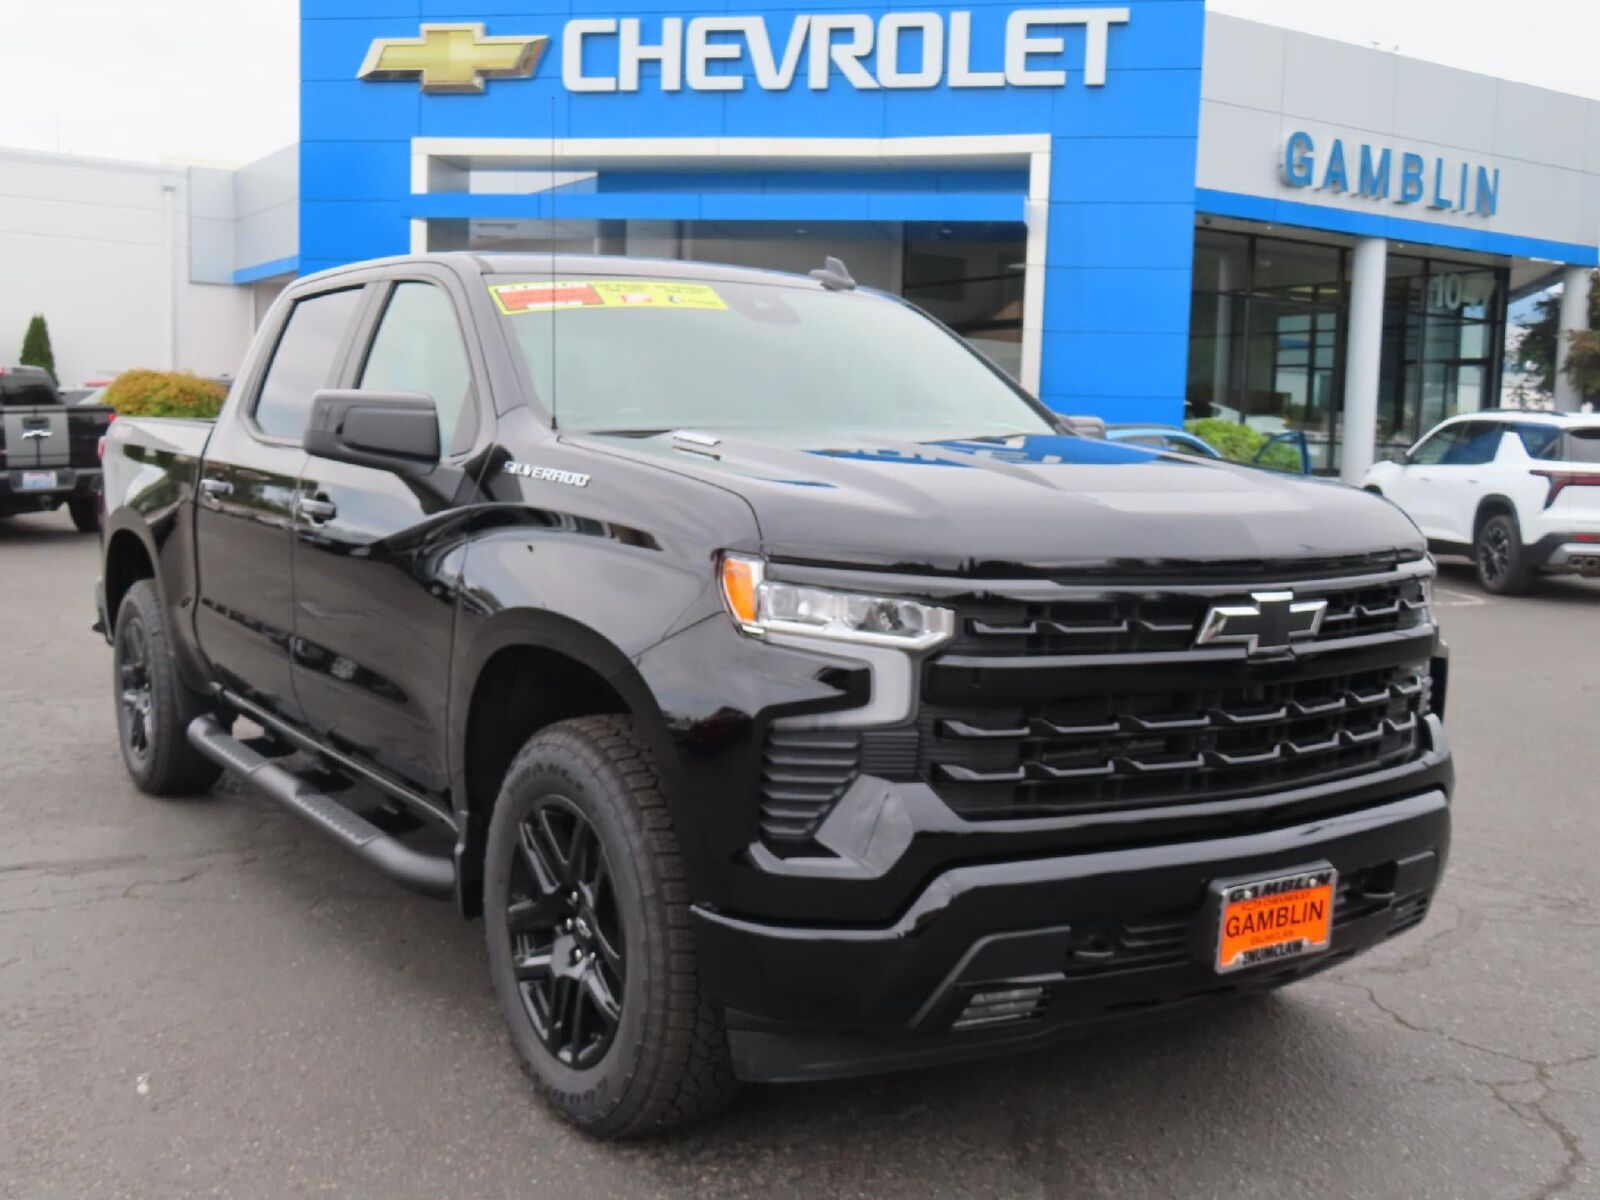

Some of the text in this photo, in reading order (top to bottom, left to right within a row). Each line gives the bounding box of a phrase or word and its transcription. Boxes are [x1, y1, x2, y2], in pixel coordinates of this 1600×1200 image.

[562, 8, 1130, 93] CHEVROLET
[1283, 130, 1499, 216] GAMBLIN
[502, 460, 591, 487] SILVERADO
[1229, 873, 1332, 902] GAMBLN
[1225, 900, 1324, 938] GAMBLIN
